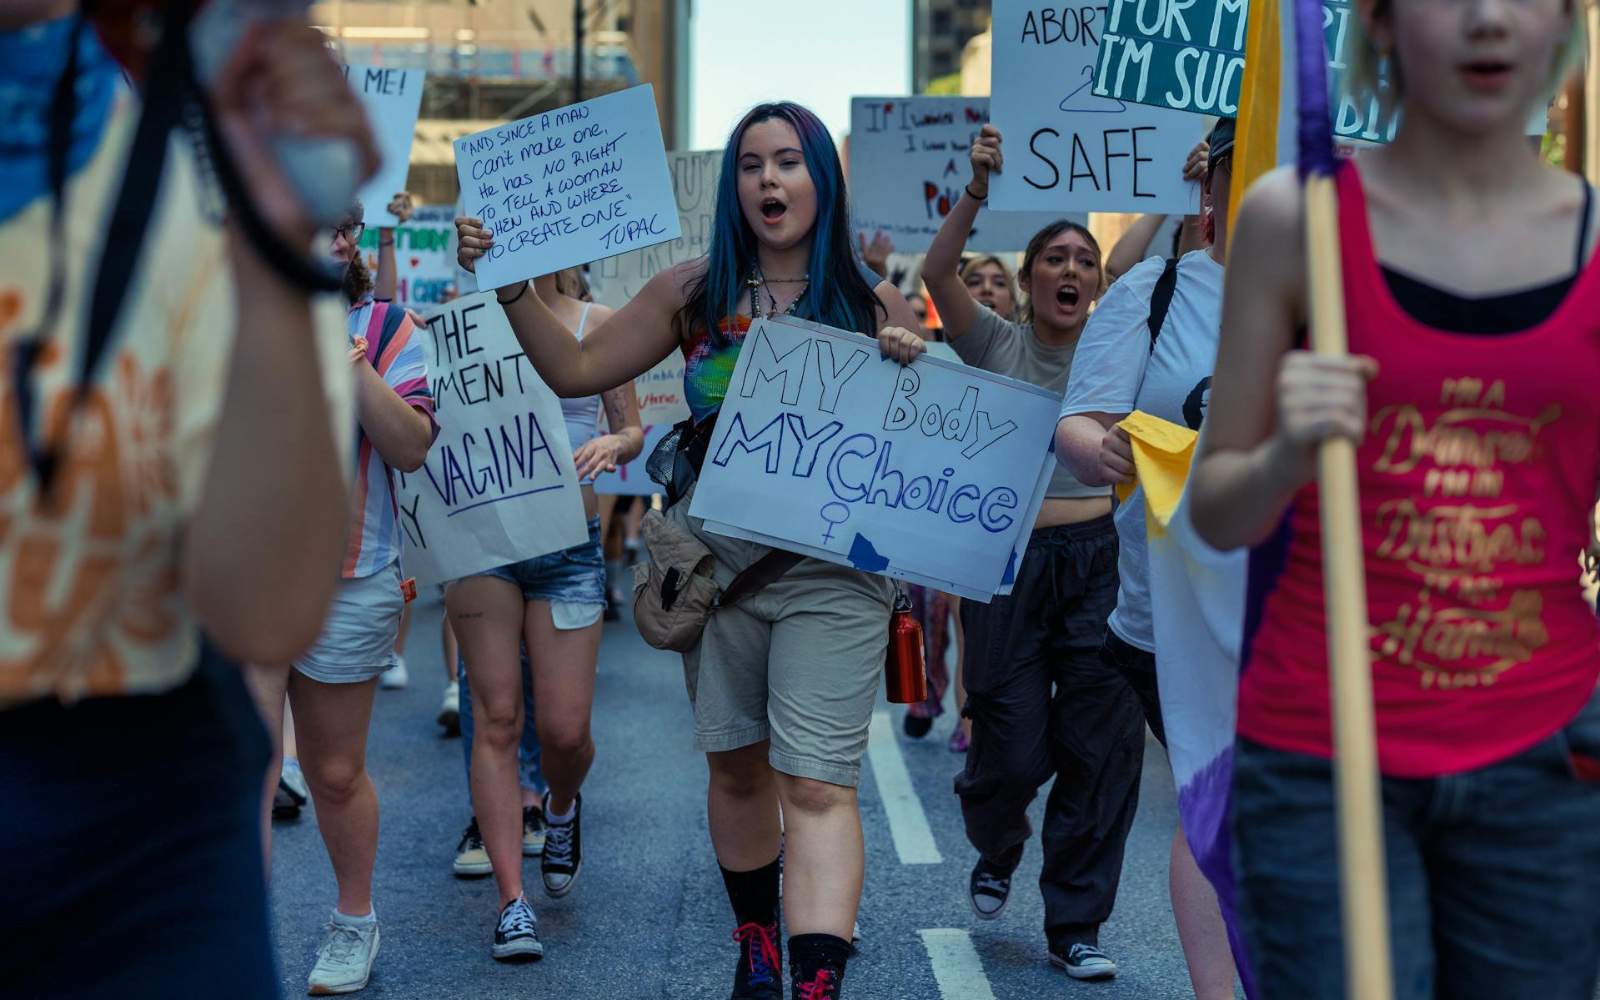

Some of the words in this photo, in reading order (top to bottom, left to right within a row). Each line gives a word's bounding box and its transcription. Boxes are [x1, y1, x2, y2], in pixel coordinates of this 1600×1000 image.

[363, 66, 408, 96] ME!
[1093, 33, 1154, 103] I'M
[499, 120, 536, 146] SINCE
[541, 114, 551, 132] A
[555, 105, 590, 127] MAN
[520, 137, 566, 163] make
[502, 172, 533, 193] has
[542, 157, 565, 180] NO
[571, 131, 628, 168] RIGHT
[1022, 125, 1157, 198] SAFE
[476, 203, 496, 224] TO
[502, 192, 540, 214] TELL
[545, 181, 554, 198] A
[530, 199, 562, 221] AND
[567, 177, 625, 209] WHERE
[507, 216, 580, 254] CREATE
[598, 213, 667, 251] TUPAC
[425, 302, 487, 368] THE
[433, 351, 526, 413] MENT
[739, 325, 870, 415] MY
[882, 363, 1018, 460] Body
[424, 412, 562, 507] VAGINA
[712, 411, 844, 479] MY
[826, 433, 1019, 534] Choice
